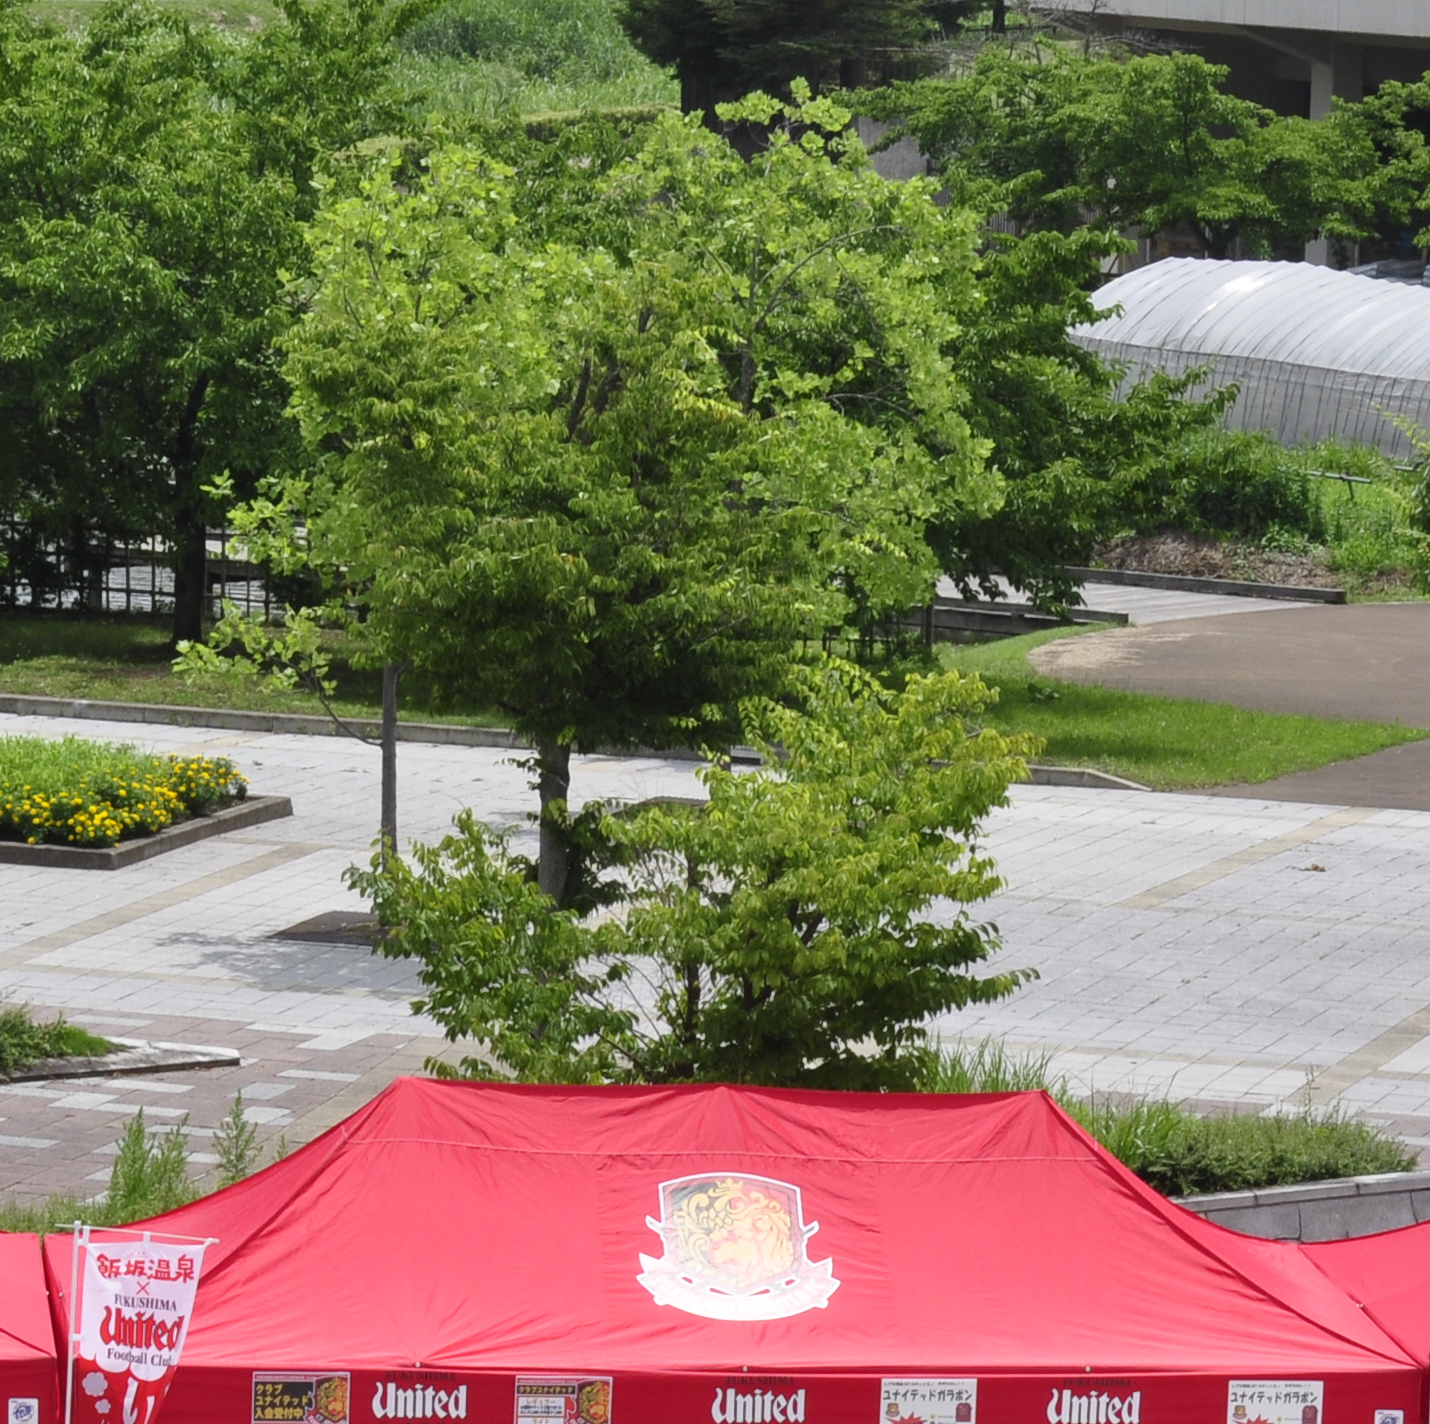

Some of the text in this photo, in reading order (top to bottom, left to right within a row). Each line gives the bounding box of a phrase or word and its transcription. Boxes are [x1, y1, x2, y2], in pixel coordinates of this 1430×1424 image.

[96, 1253, 195, 1284] 飯坂温泉
[114, 1293, 178, 1312] FUKUSHIMA
[99, 1305, 186, 1351] United
[106, 1347, 148, 1365] Football
[255, 1383, 284, 1396] クラブ
[255, 1395, 310, 1407] ユナイテッド
[372, 1381, 468, 1420] United
[711, 1387, 806, 1424] United
[254, 1407, 304, 1420] 入会受付中
